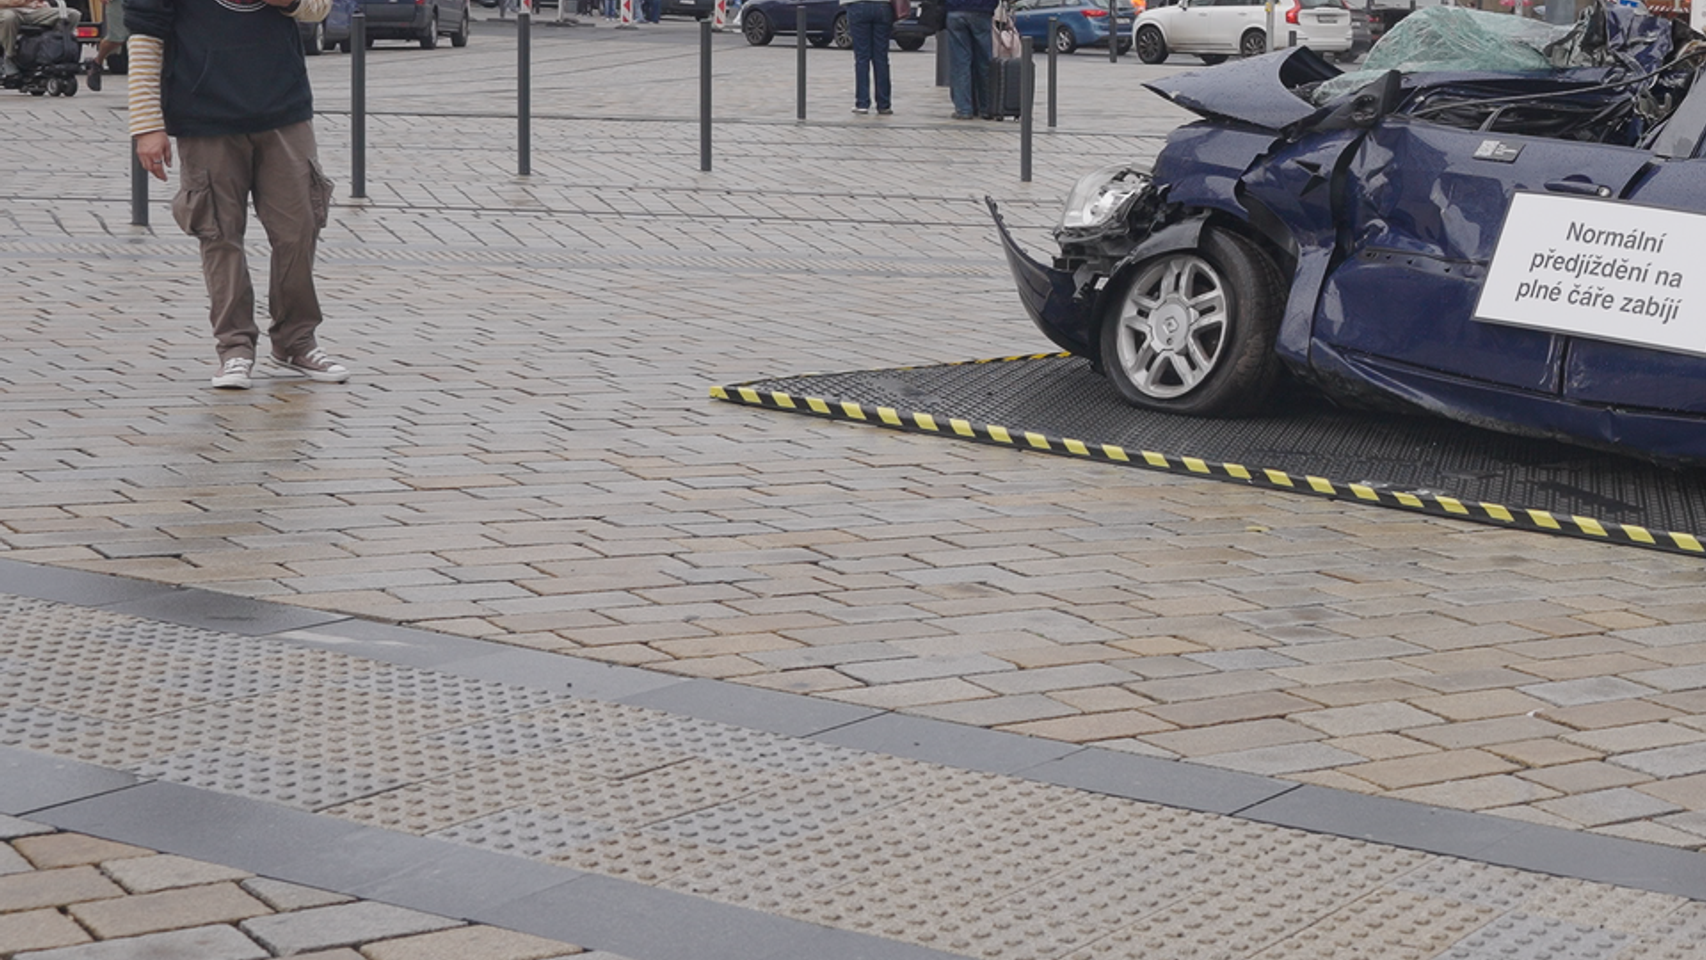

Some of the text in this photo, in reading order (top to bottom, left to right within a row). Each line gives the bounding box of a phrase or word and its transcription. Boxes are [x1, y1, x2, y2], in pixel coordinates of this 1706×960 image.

[1566, 222, 1668, 253] Normální
[1529, 248, 1683, 288] předjíždění na
[1515, 278, 1683, 325] plné čáře zabíjí
